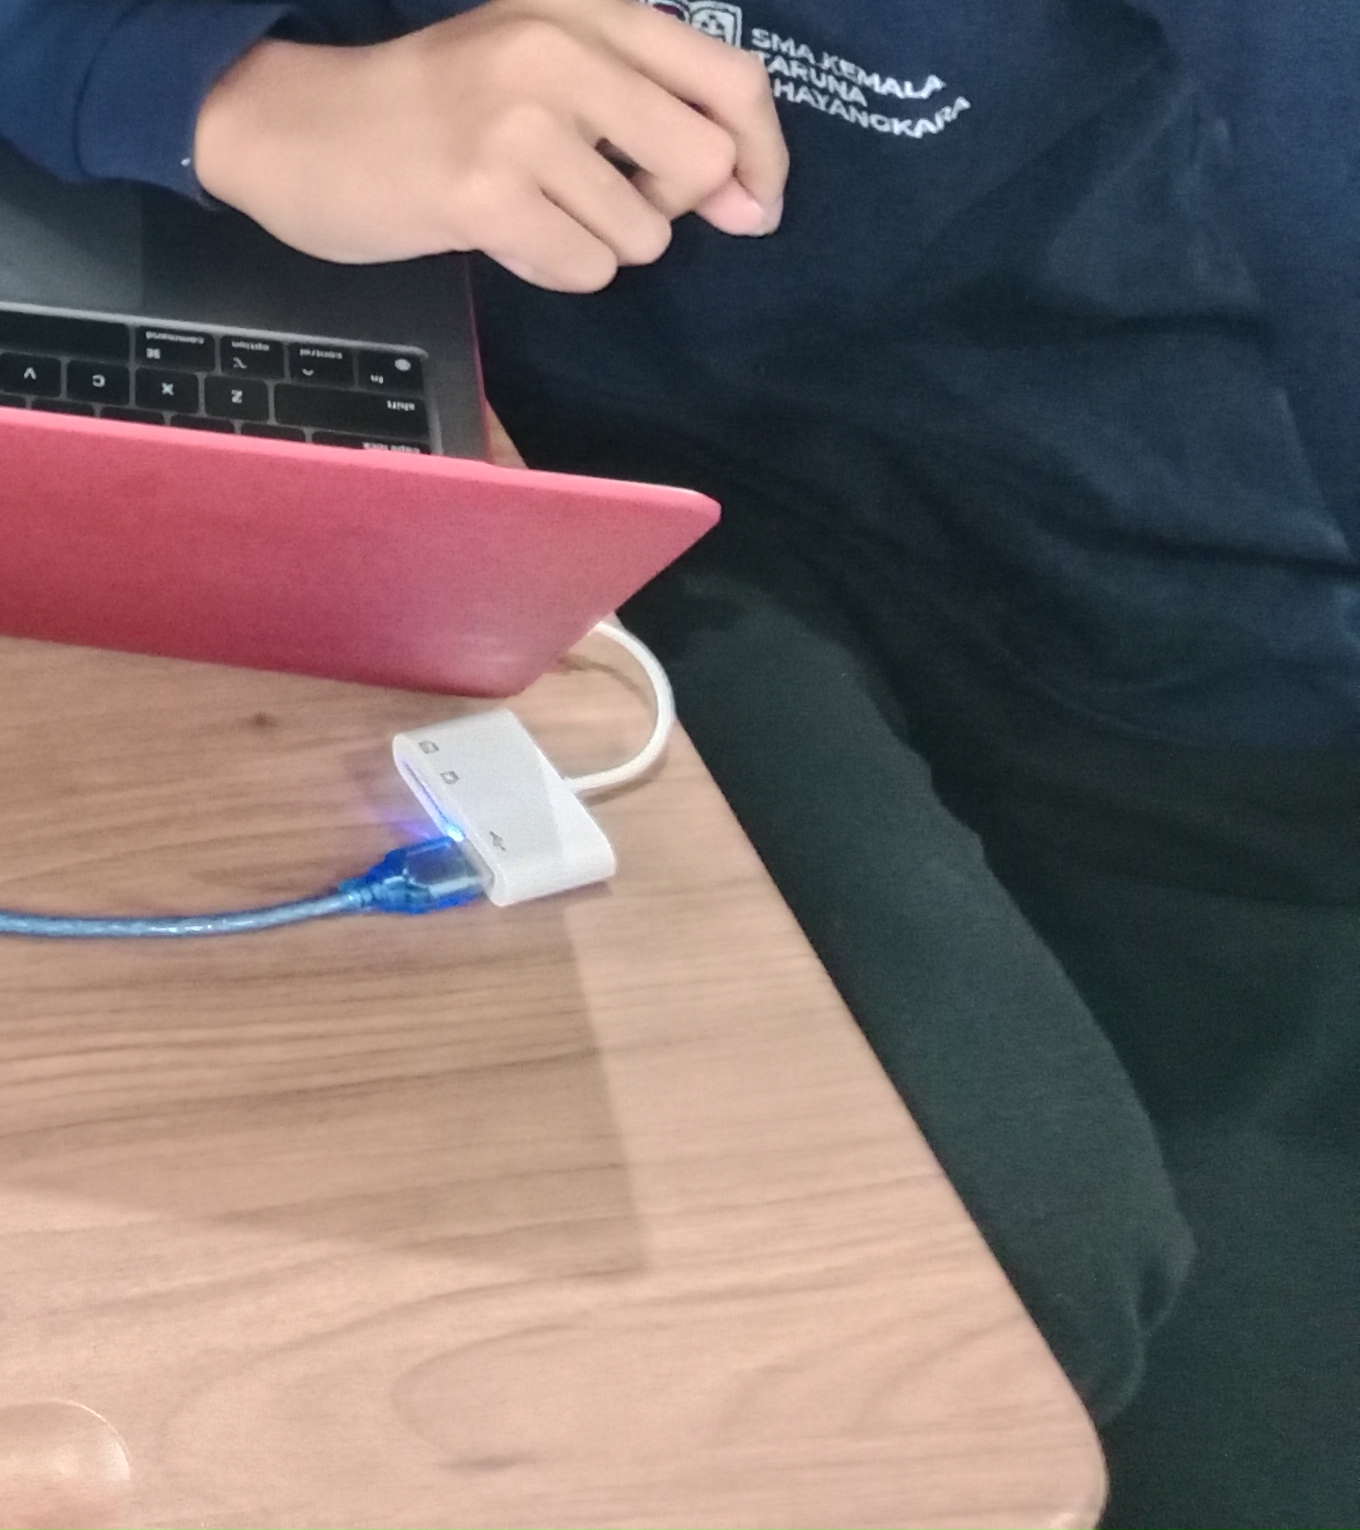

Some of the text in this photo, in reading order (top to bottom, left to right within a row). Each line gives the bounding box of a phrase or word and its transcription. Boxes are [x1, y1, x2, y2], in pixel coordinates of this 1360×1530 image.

[751, 27, 947, 100] SMA KEMALA
[773, 77, 972, 139] HAYANGKARA
[231, 341, 270, 352] option
[299, 348, 343, 360] control
[23, 367, 38, 381] V
[92, 374, 106, 388] C
[161, 382, 174, 396] X
[231, 389, 243, 405] Z
[386, 400, 416, 412] shift
